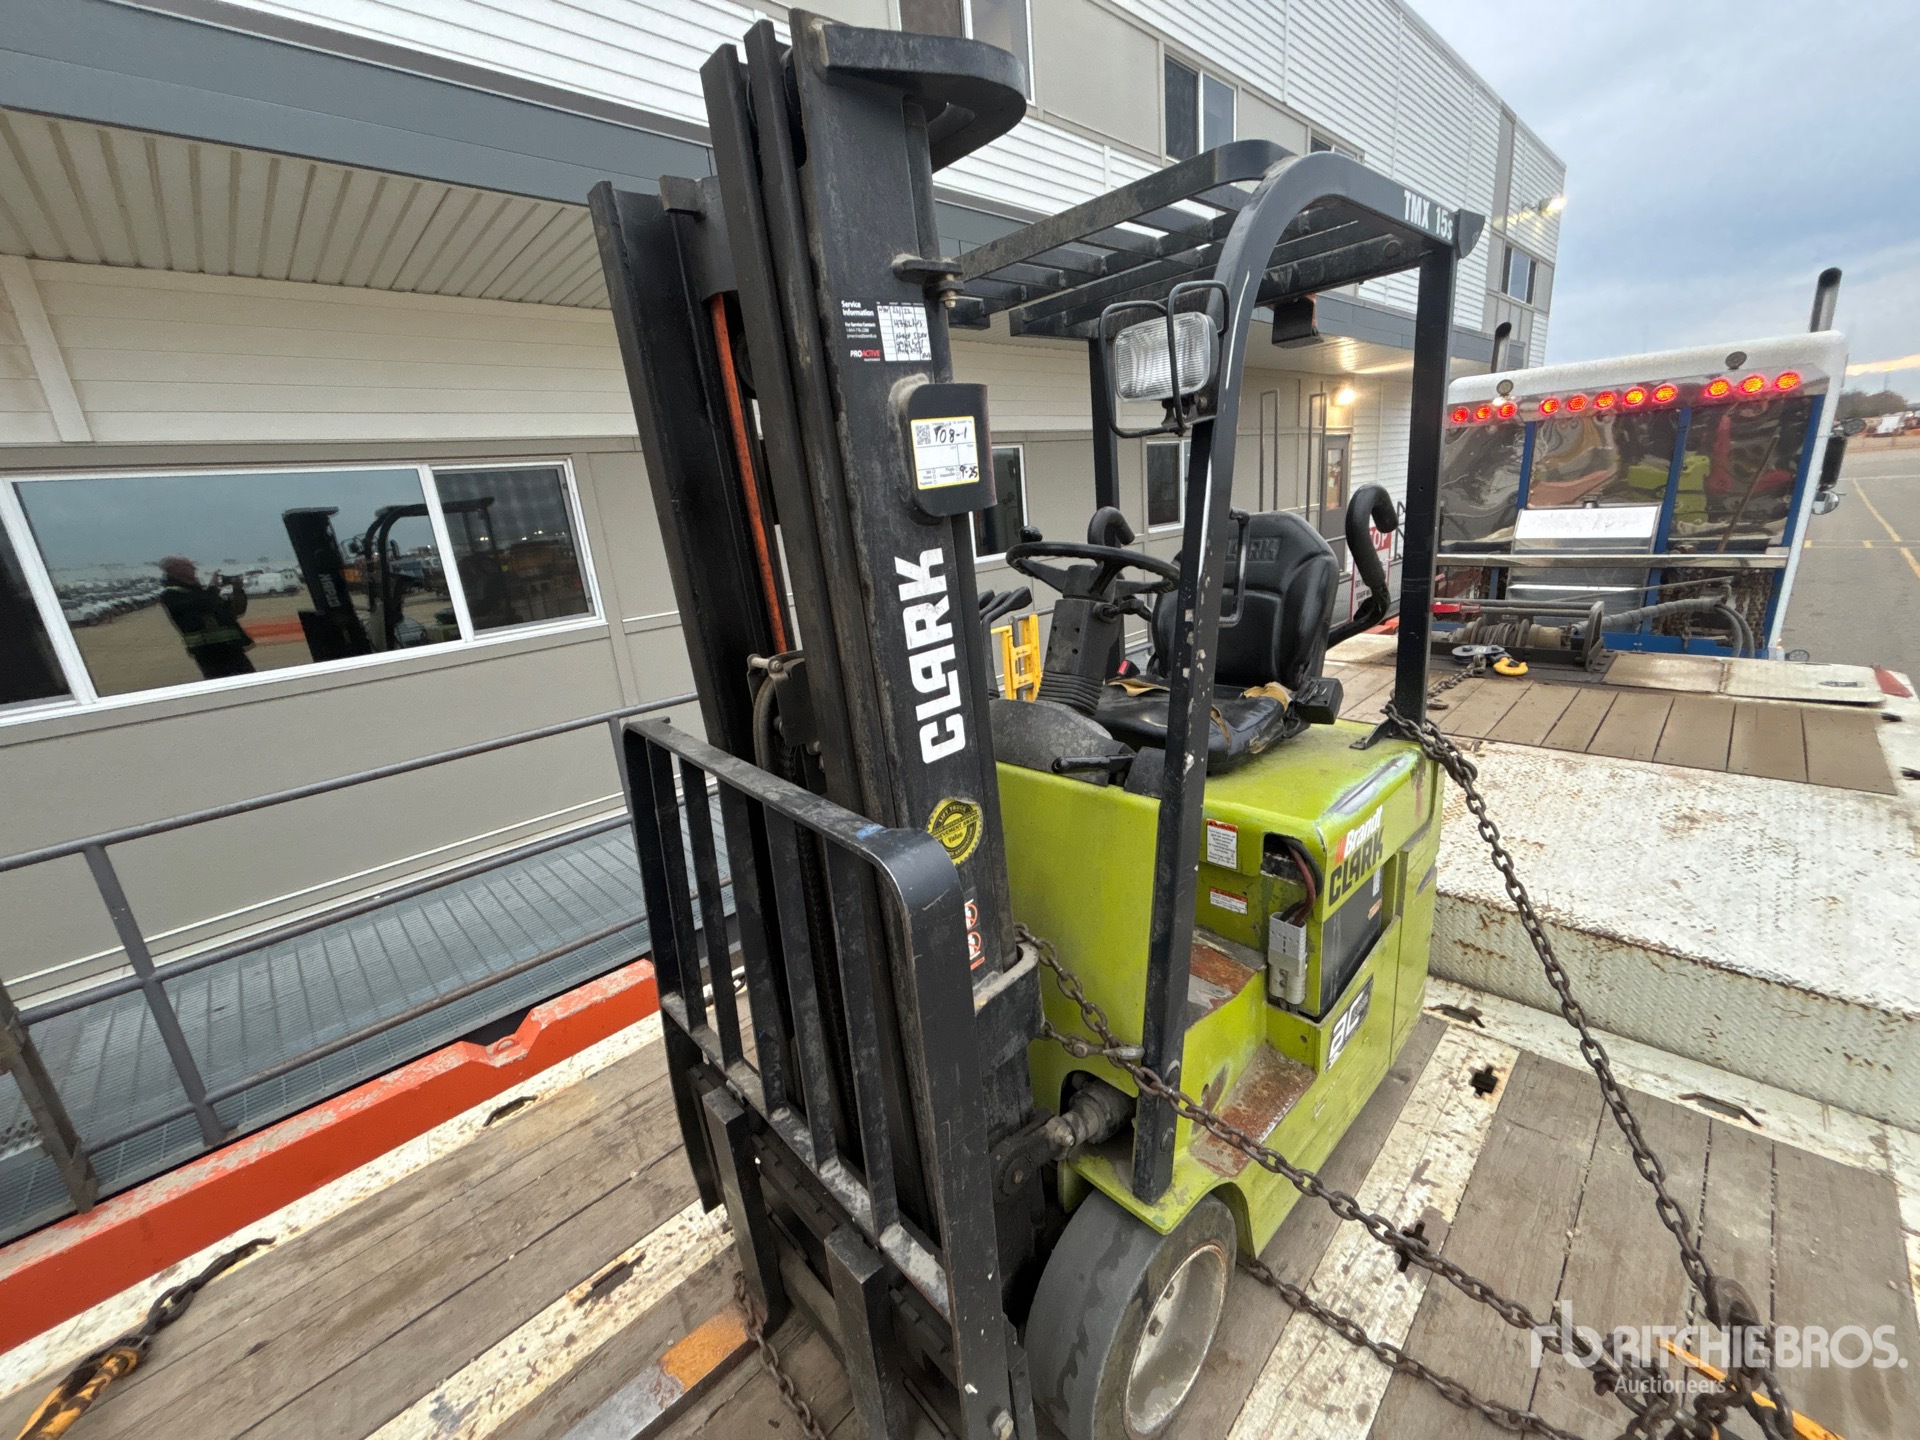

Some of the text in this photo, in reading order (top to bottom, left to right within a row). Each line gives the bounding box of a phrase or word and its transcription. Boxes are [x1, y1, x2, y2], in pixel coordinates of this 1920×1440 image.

[1404, 189, 1430, 230] TMX
[841, 300, 861, 308] Service
[842, 309, 874, 317] Information
[894, 548, 966, 764] CLARK
[1344, 804, 1383, 859] Brandt
[1328, 826, 1385, 907] CLARK
